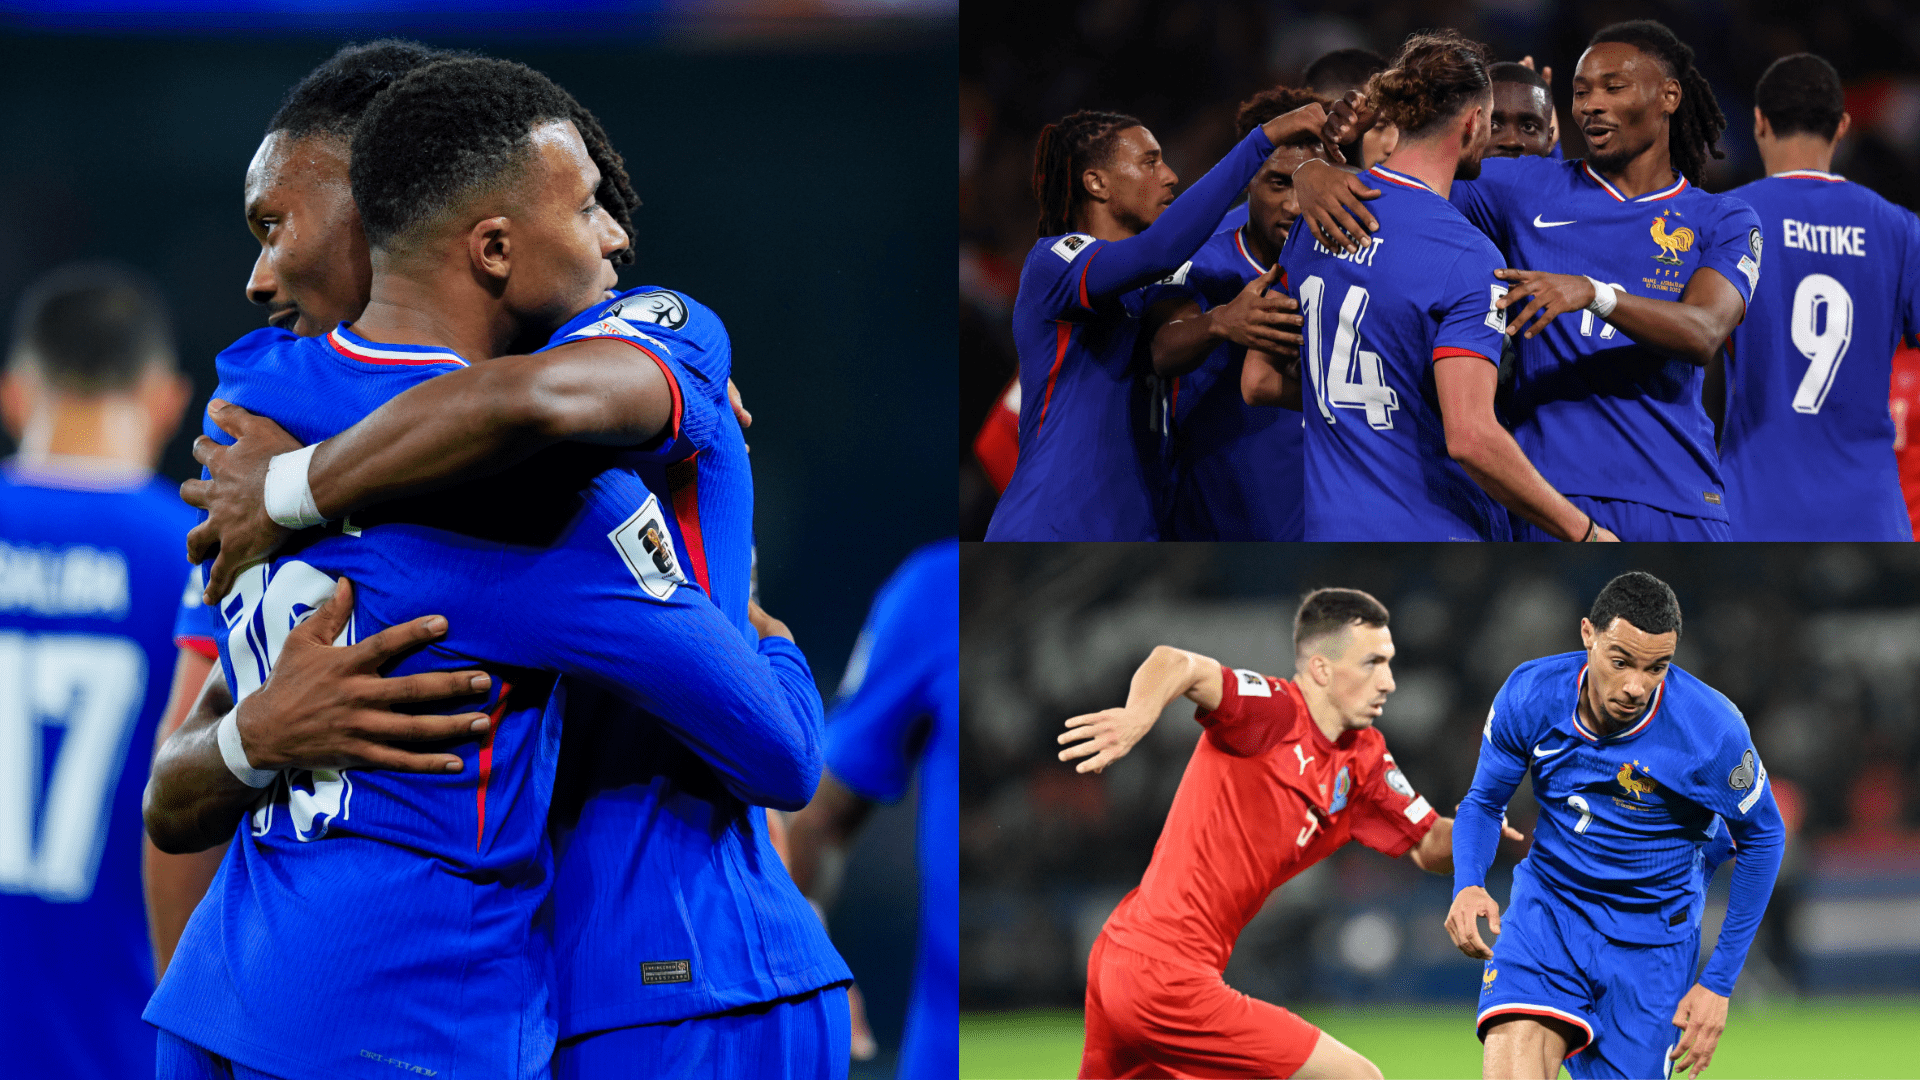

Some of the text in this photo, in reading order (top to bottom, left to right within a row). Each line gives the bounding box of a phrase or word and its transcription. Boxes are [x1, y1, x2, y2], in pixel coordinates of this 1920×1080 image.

[1783, 218, 1866, 257] EKITIKE
[1299, 275, 1399, 430] 14
[1791, 273, 1853, 415] 9
